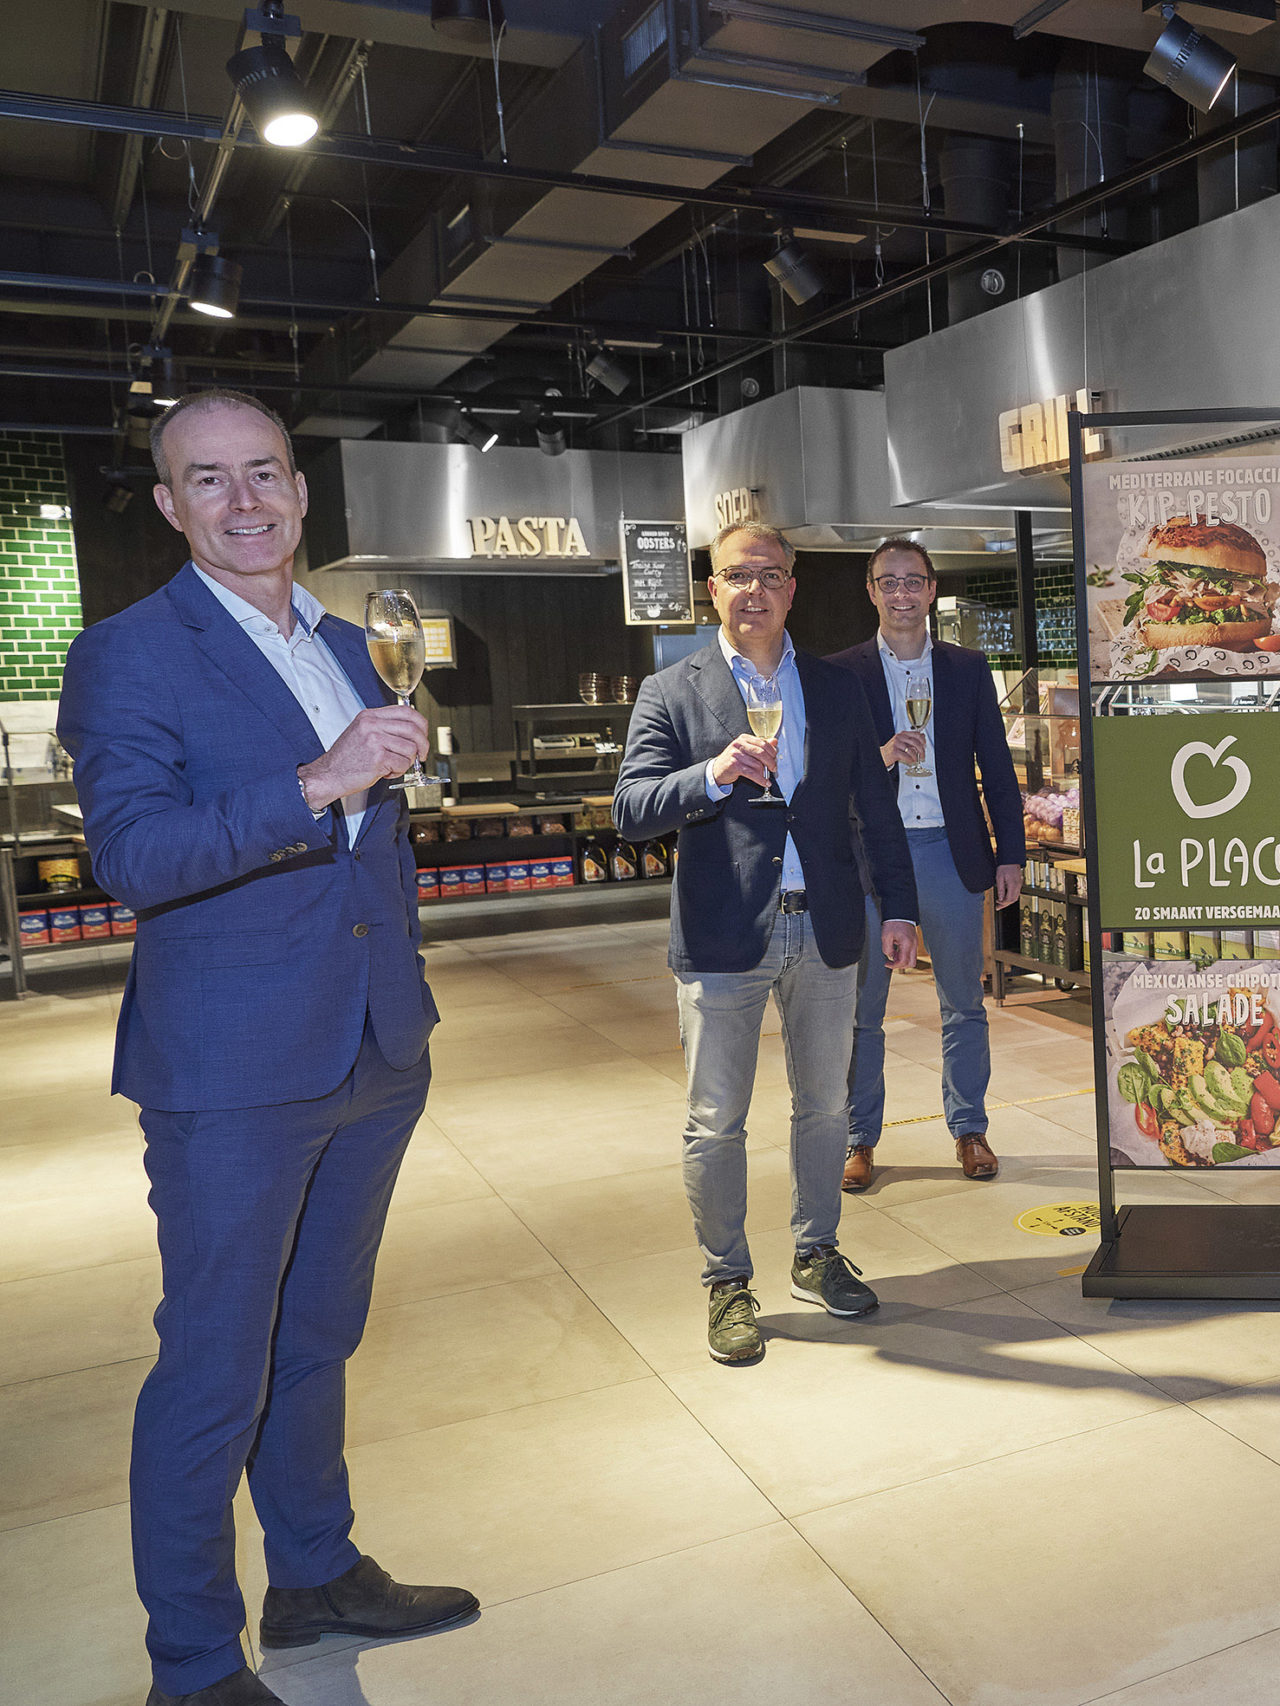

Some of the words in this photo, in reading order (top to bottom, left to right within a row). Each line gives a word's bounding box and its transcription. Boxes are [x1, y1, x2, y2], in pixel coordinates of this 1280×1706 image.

[1109, 469, 1213, 490] MEDITERRANE
[468, 516, 591, 556] PASTA
[637, 537, 676, 550] OOSTERS
[1133, 839, 1166, 888] La
[1134, 907, 1150, 920] ZO
[1153, 906, 1202, 920] SMAAKT
[1132, 973, 1223, 990] MEXICAANSE
[1166, 993, 1264, 1027] SALADE
